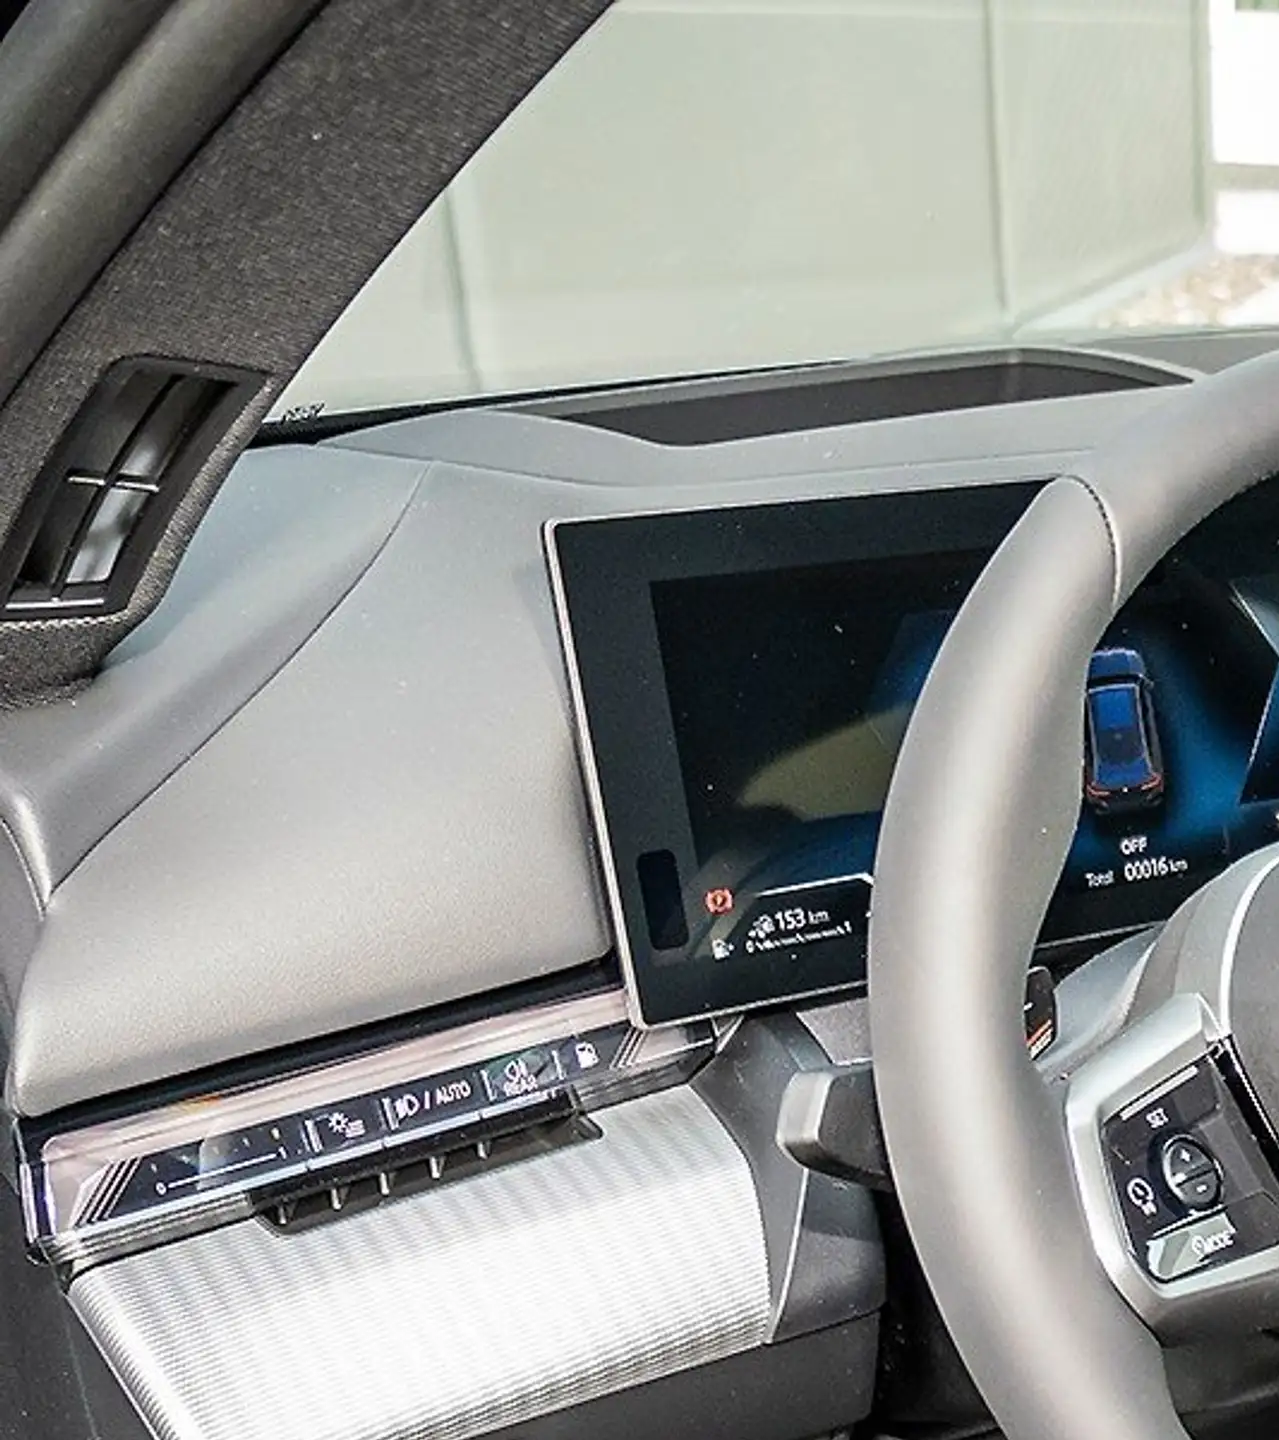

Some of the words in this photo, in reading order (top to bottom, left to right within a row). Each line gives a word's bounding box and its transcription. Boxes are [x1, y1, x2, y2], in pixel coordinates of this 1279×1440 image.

[1121, 836, 1147, 855] OFF
[1124, 856, 1168, 881] 00016
[774, 908, 806, 931] 153
[435, 1080, 472, 1104] AUTO
